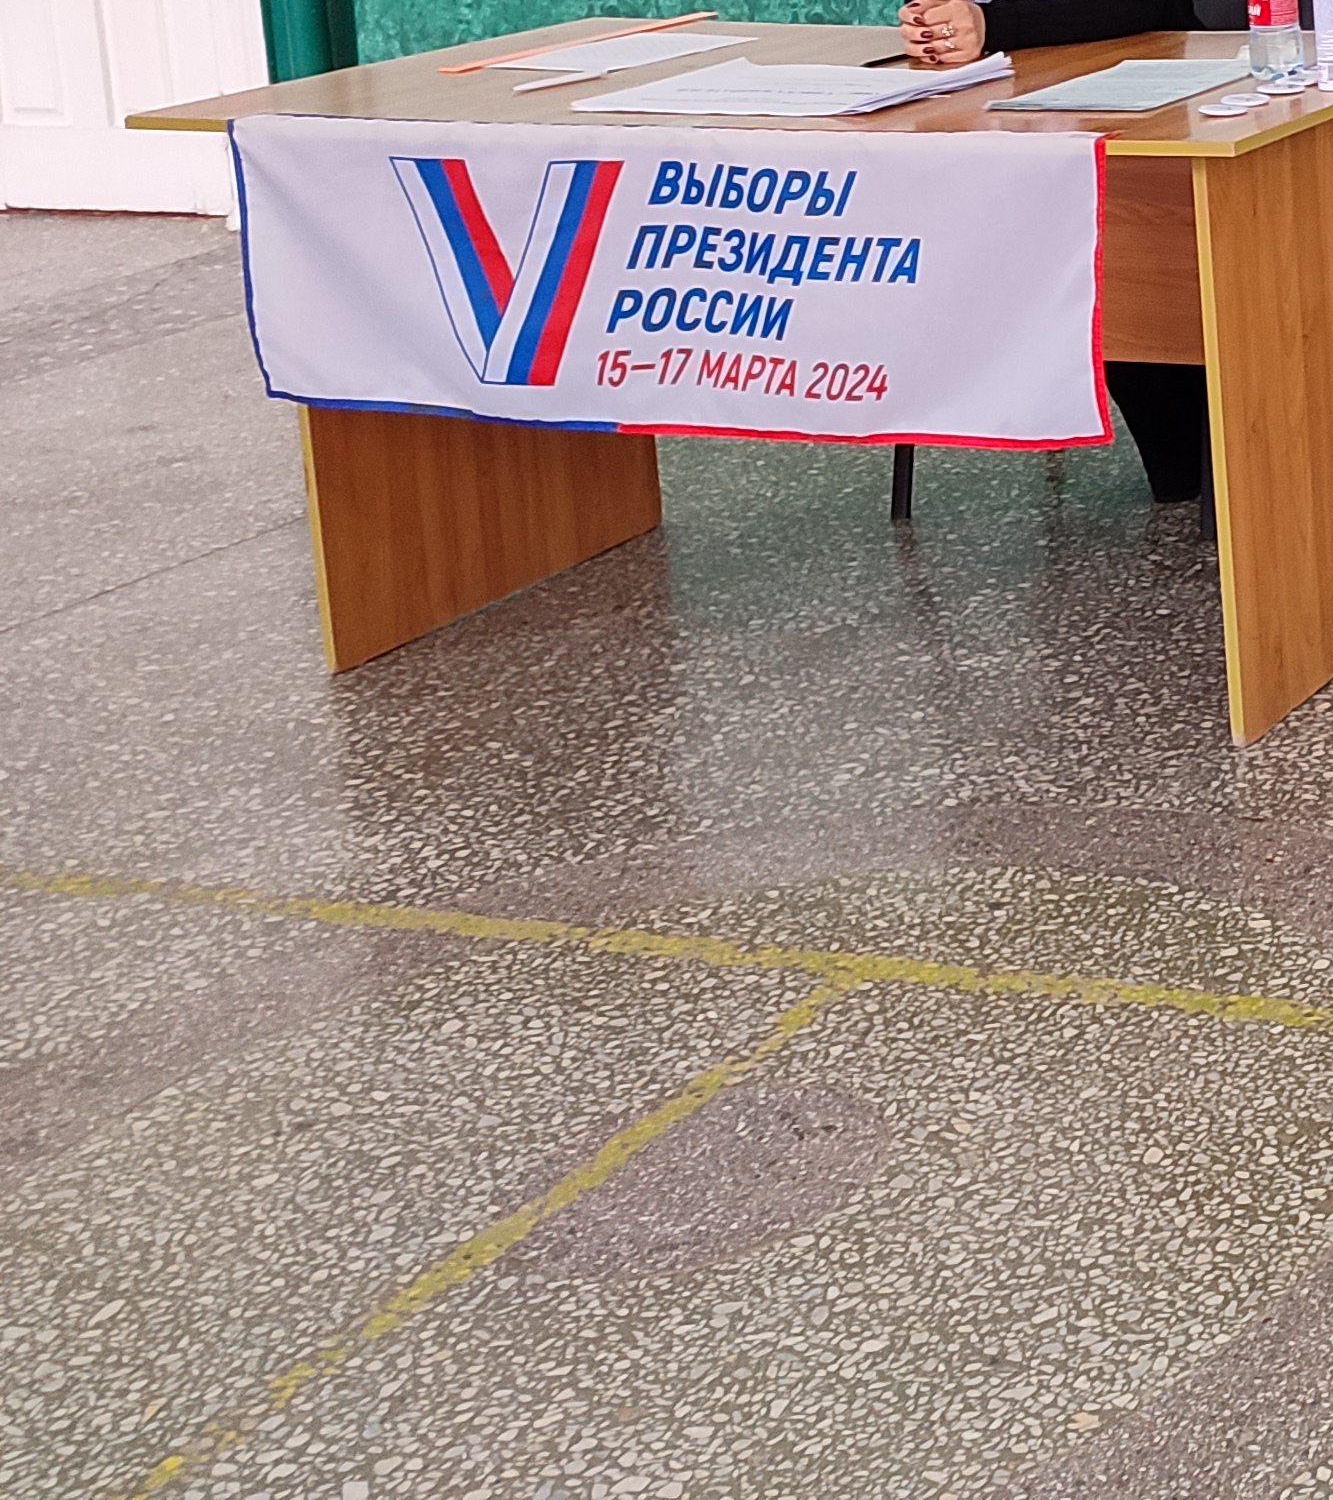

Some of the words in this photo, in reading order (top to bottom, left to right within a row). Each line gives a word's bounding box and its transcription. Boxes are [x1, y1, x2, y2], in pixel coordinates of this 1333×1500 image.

[647, 160, 857, 219] ВЫБОРЫ
[626, 224, 923, 286] ПРЕЗИДЕНТА
[605, 287, 794, 342] РОССИИ
[695, 351, 804, 397] МАРТА
[808, 361, 889, 403] 2024
